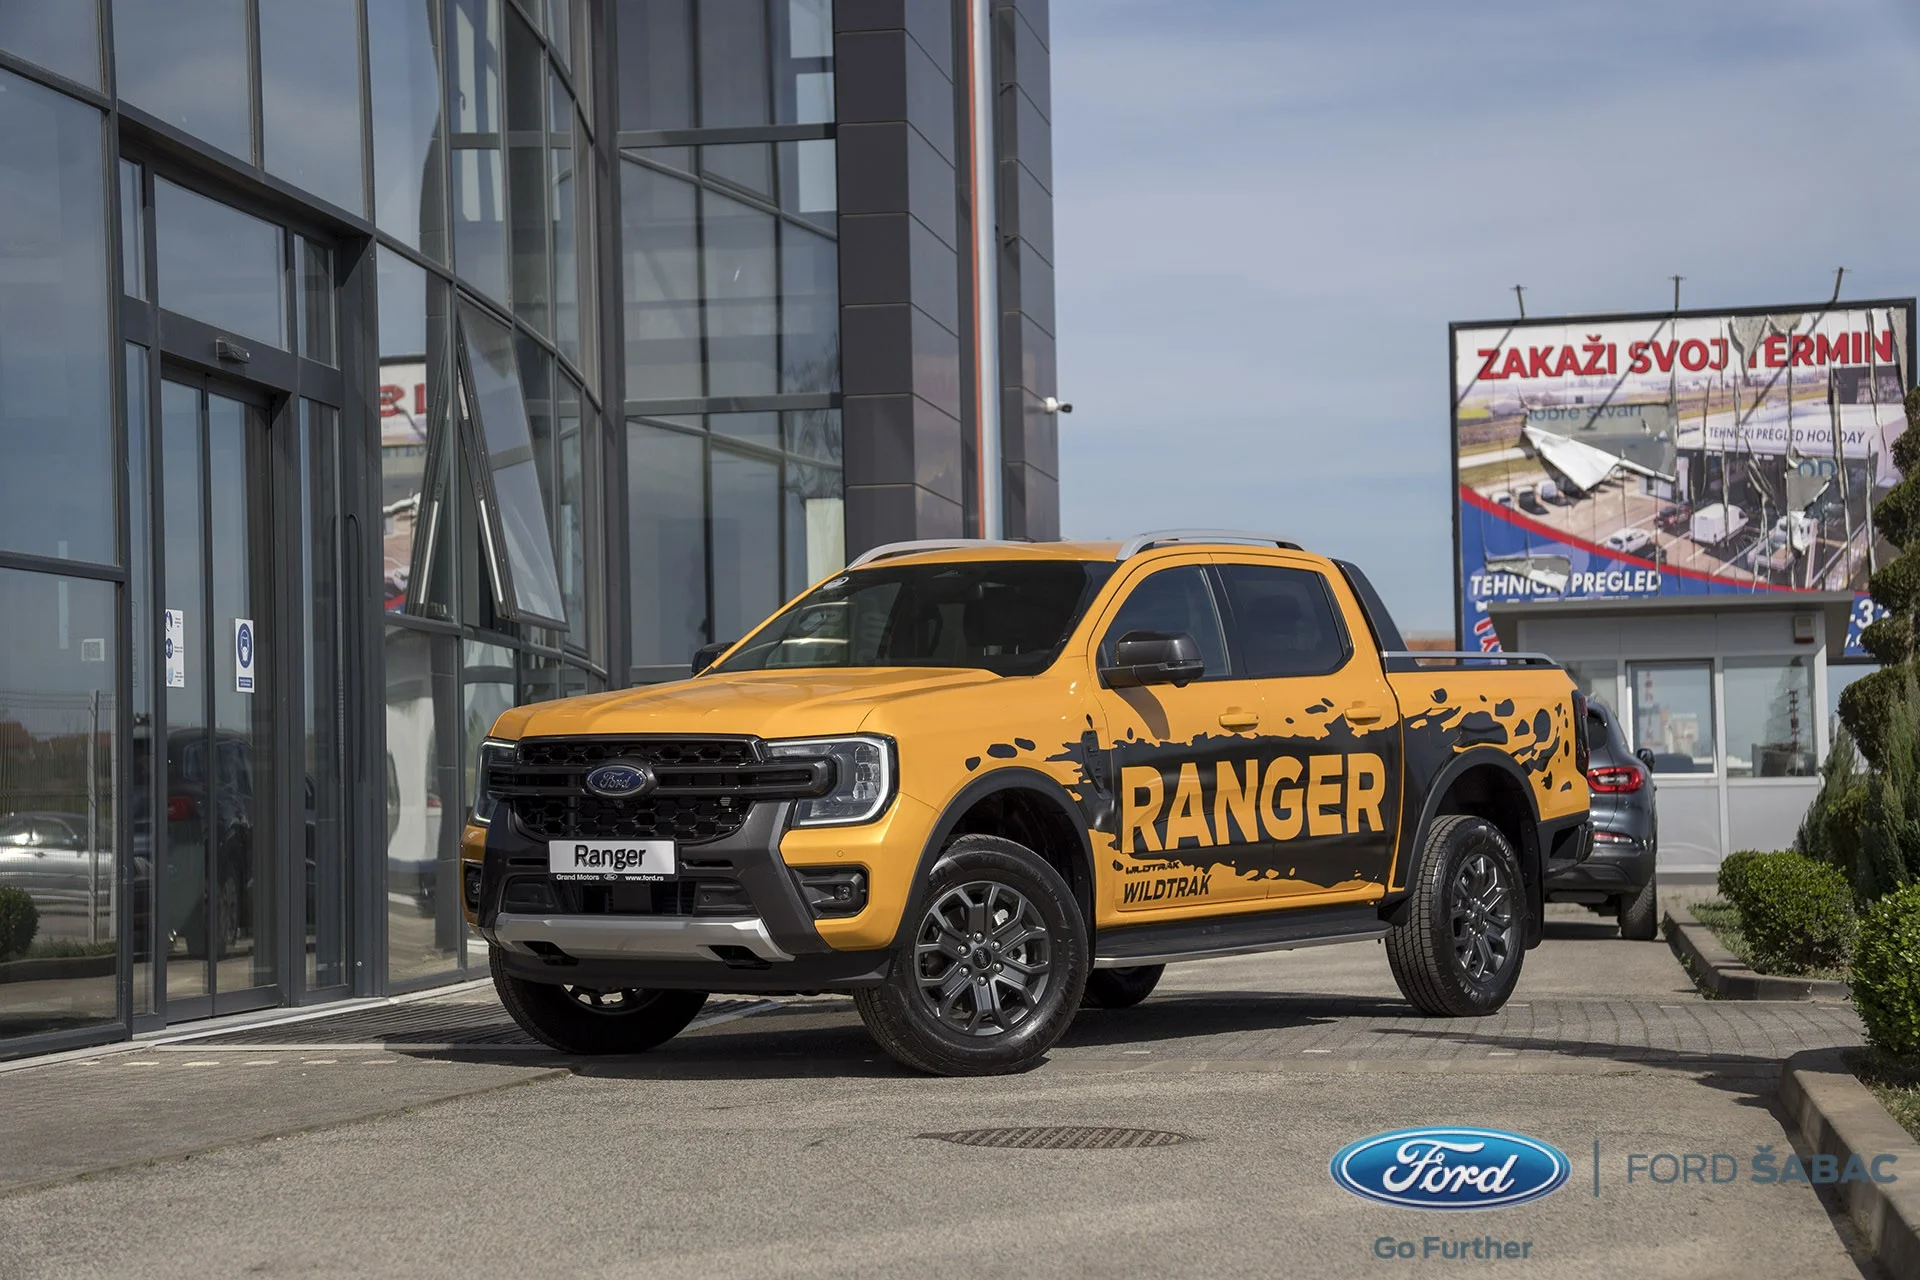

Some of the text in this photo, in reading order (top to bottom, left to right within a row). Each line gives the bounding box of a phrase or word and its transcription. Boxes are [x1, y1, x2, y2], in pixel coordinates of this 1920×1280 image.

[1477, 334, 1617, 380] ZAKAŽI
[1628, 338, 1729, 375] SVOJ
[1807, 429, 1866, 444] HOLDAY
[1470, 570, 1662, 597] TEHNI PREGLED
[599, 772, 633, 789] Ford
[1121, 752, 1386, 854] RANGER
[574, 845, 647, 872] Ranger
[1125, 861, 1180, 875] WILDTRAK
[556, 873, 576, 881] Grand
[625, 874, 664, 882] www.ford.rs
[1123, 874, 1212, 905] WILDTRAK
